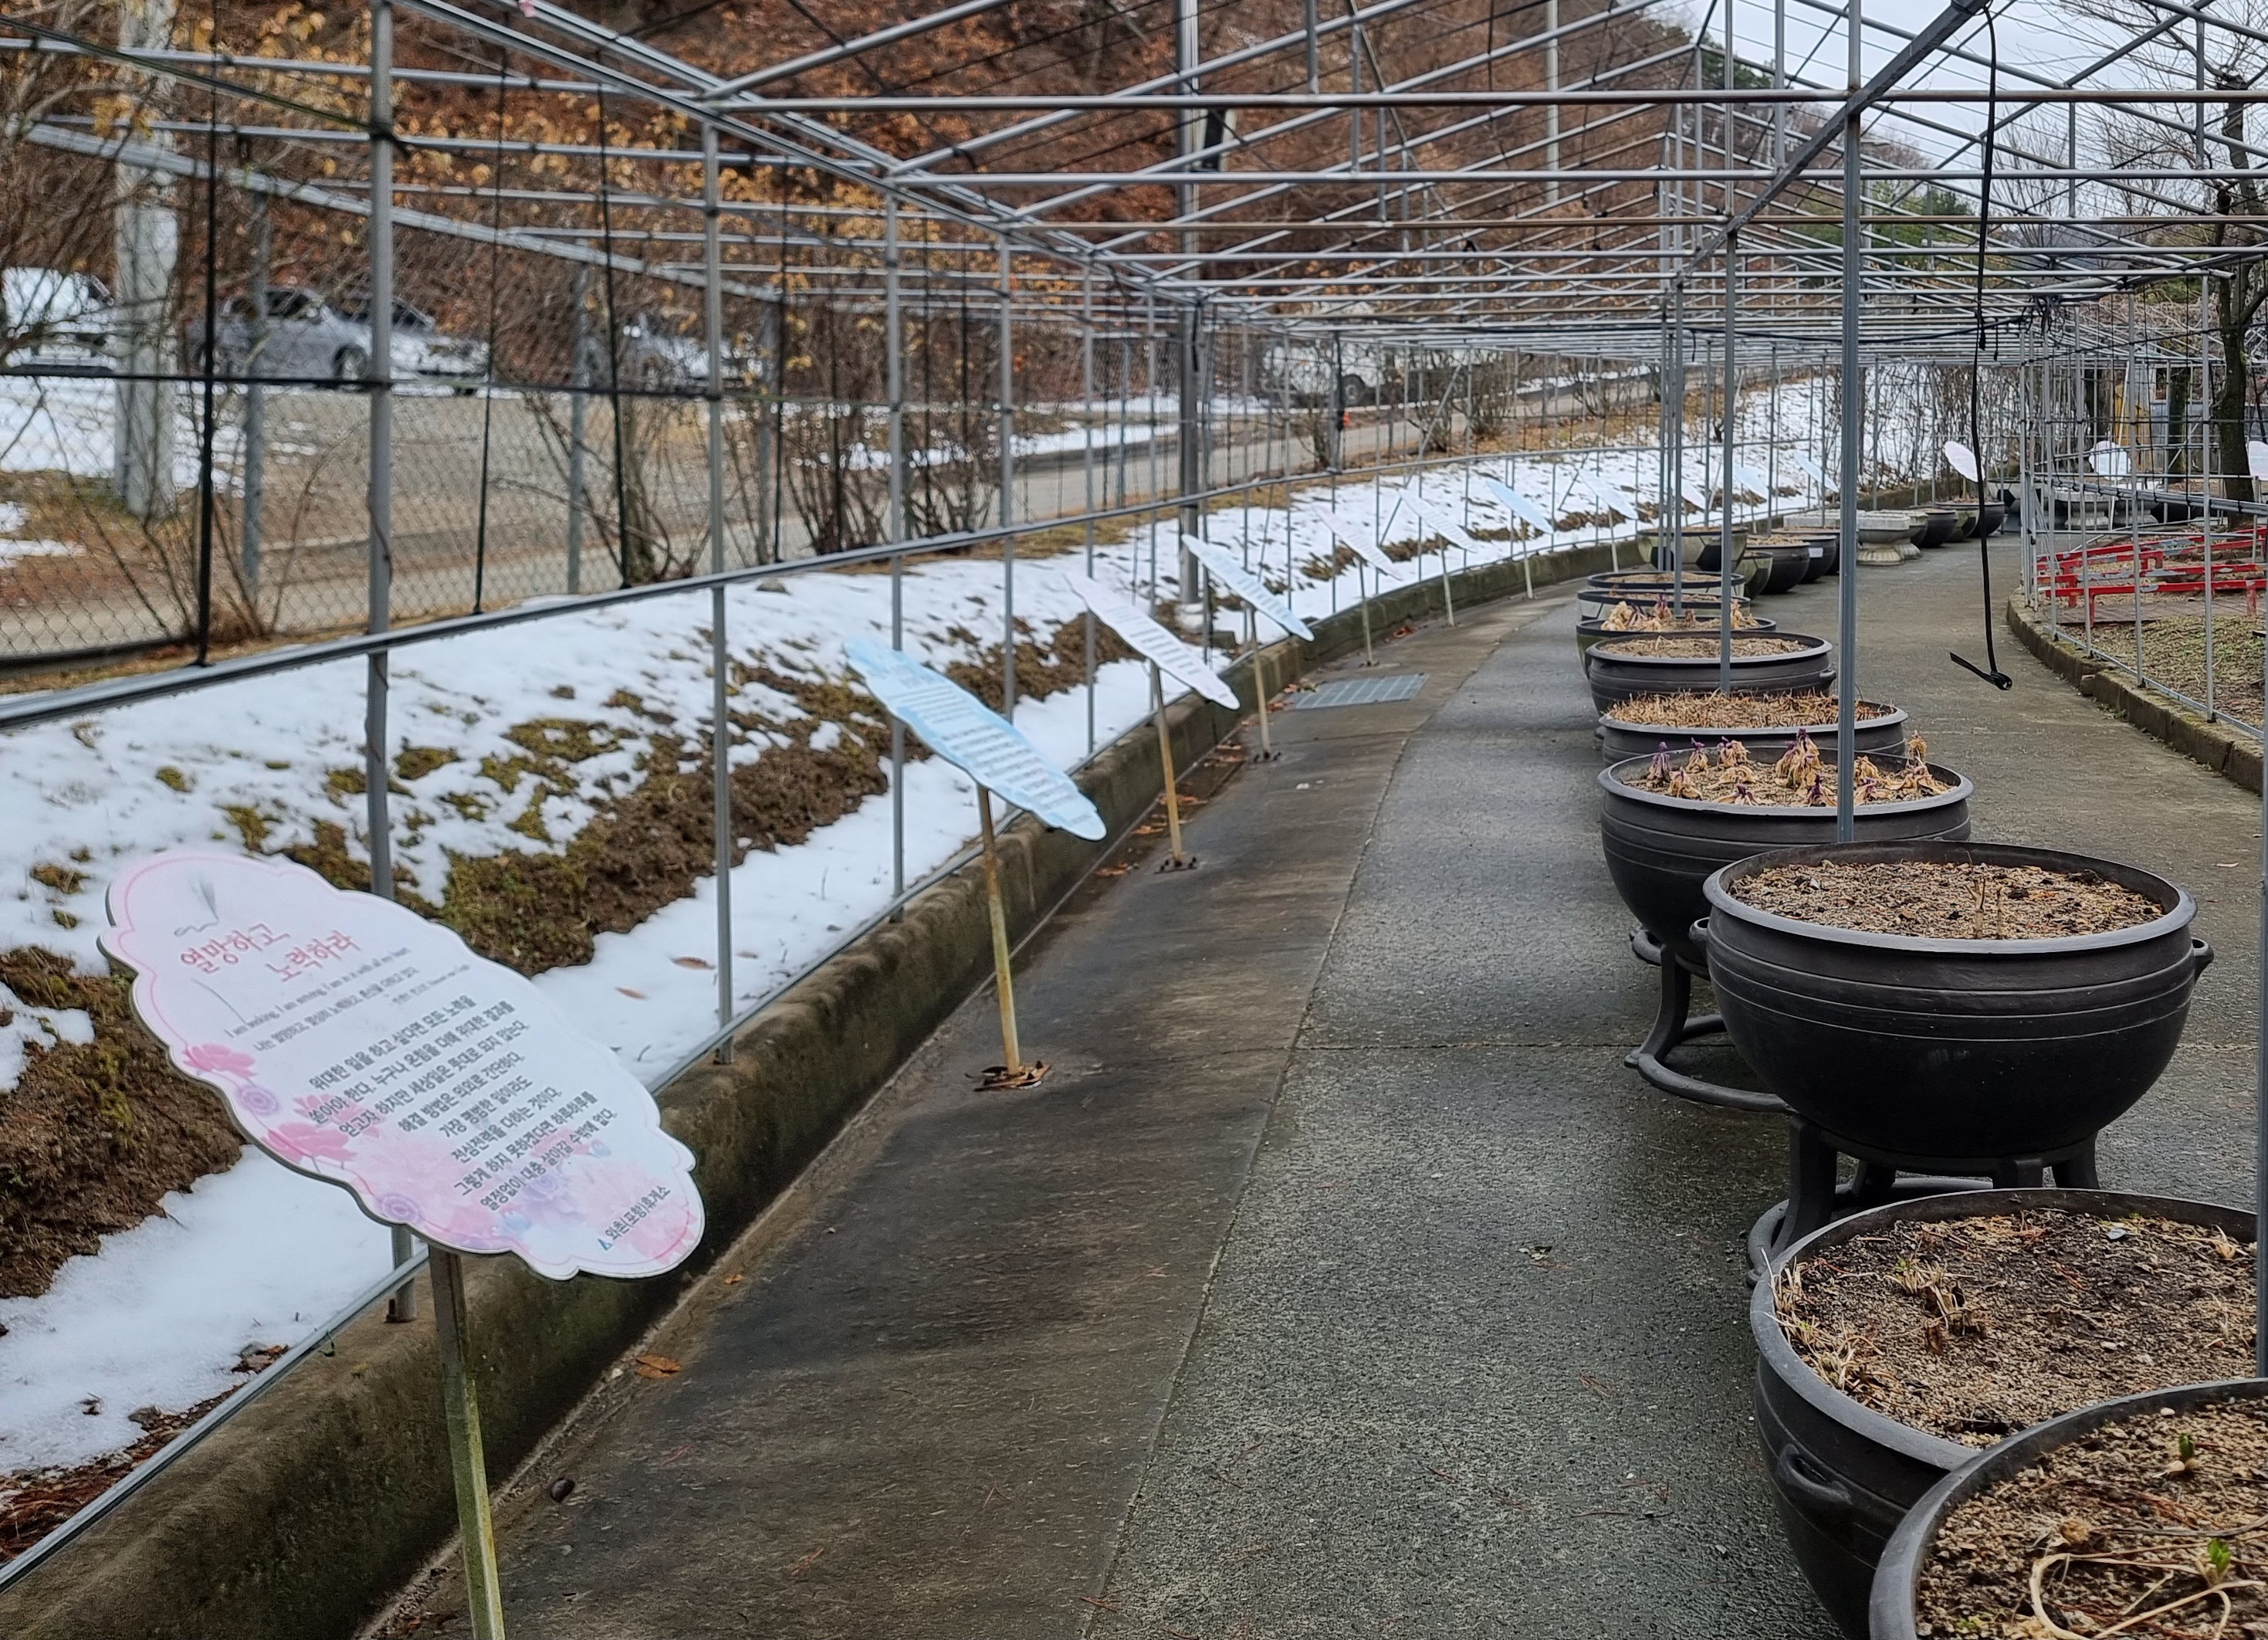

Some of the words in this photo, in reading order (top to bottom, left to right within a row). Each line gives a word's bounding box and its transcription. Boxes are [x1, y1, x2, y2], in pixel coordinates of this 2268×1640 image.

[181, 923, 291, 974] 열망하고
[266, 930, 361, 982] 노력하라
[309, 1063, 350, 1090] 위대한
[344, 1051, 374, 1071] 일을
[368, 1039, 397, 1057] 하고
[391, 1022, 429, 1045] 싶다면
[422, 1010, 449, 1028] 모든
[442, 995, 477, 1016] 노력을
[309, 1096, 350, 1125] 쏟아야
[344, 1081, 377, 1103] 한다.
[371, 1060, 411, 1086] 누구나
[403, 1043, 441, 1068] 온힘을
[455, 1015, 489, 1038] 위대한
[482, 1000, 516, 1022] 결과를
[339, 1110, 381, 1137] 얻고자
[374, 1089, 415, 1115] 하지만
[408, 1064, 455, 1094] 세상일은
[448, 1047, 483, 1072] 뜻대로
[477, 1035, 503, 1052] 되지
[398, 1112, 428, 1132] 해결
[420, 1093, 459, 1118] 방법은
[452, 1074, 488, 1098] 의외로
[439, 1118, 467, 1137] 가장
[460, 1099, 497, 1125] 평범한
[490, 1075, 533, 1104] 일이라도
[451, 1124, 507, 1164] 전심전력을
[499, 1106, 535, 1128] 다하는
[527, 1086, 563, 1110] 것이다.
[454, 1167, 493, 1196] 그렇게
[485, 1152, 513, 1173] 하지
[506, 1120, 557, 1158] 못하겠다면
[550, 1091, 598, 1125] 하루하루를
[479, 1175, 527, 1211] 열정없이
[520, 1161, 547, 1180] 대충
[541, 1140, 574, 1166] 살아갈
[569, 1121, 599, 1145] 수밖에
[593, 1107, 618, 1127] 없다.
[604, 1185, 671, 1240] 와촌(포항)휴게소
